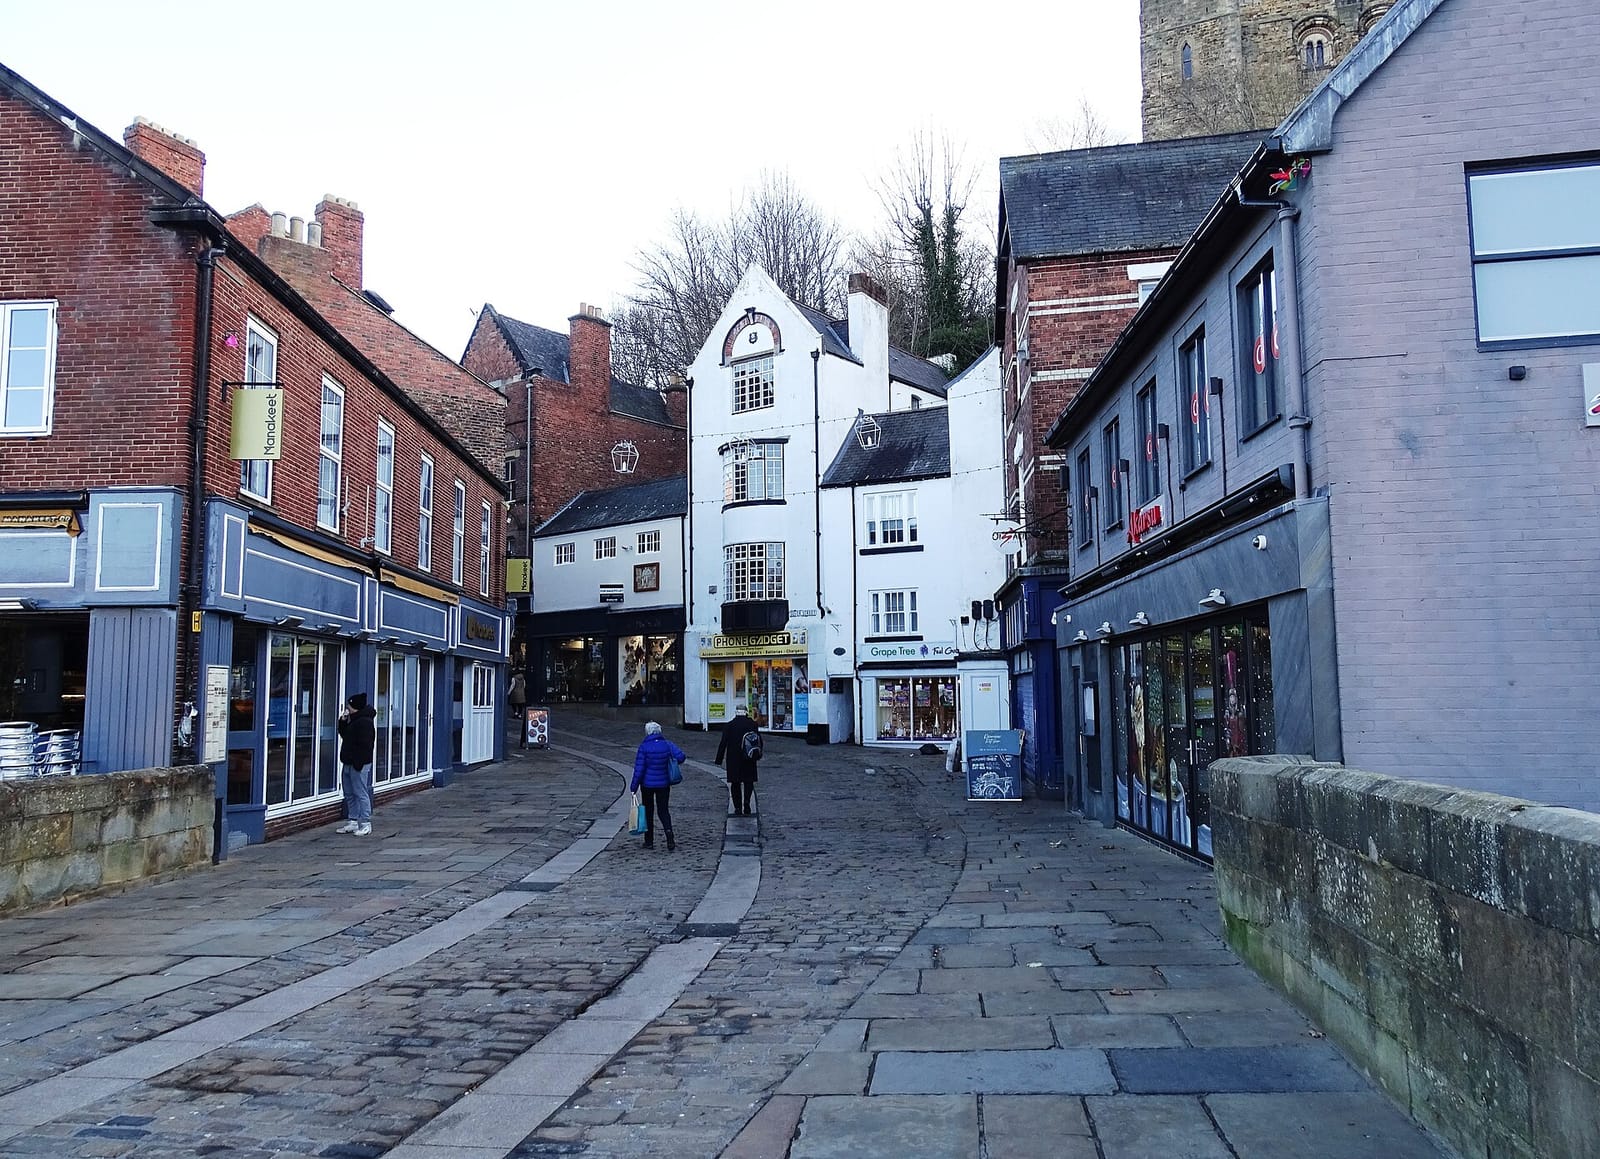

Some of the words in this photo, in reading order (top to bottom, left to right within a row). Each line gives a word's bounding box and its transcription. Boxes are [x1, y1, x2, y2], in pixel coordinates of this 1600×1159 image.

[264, 393, 277, 455] Manakeet
[715, 636, 749, 648] PHONE
[749, 633, 789, 646] GADGET
[870, 647, 897, 658] Grape
[898, 646, 916, 656] Tree
